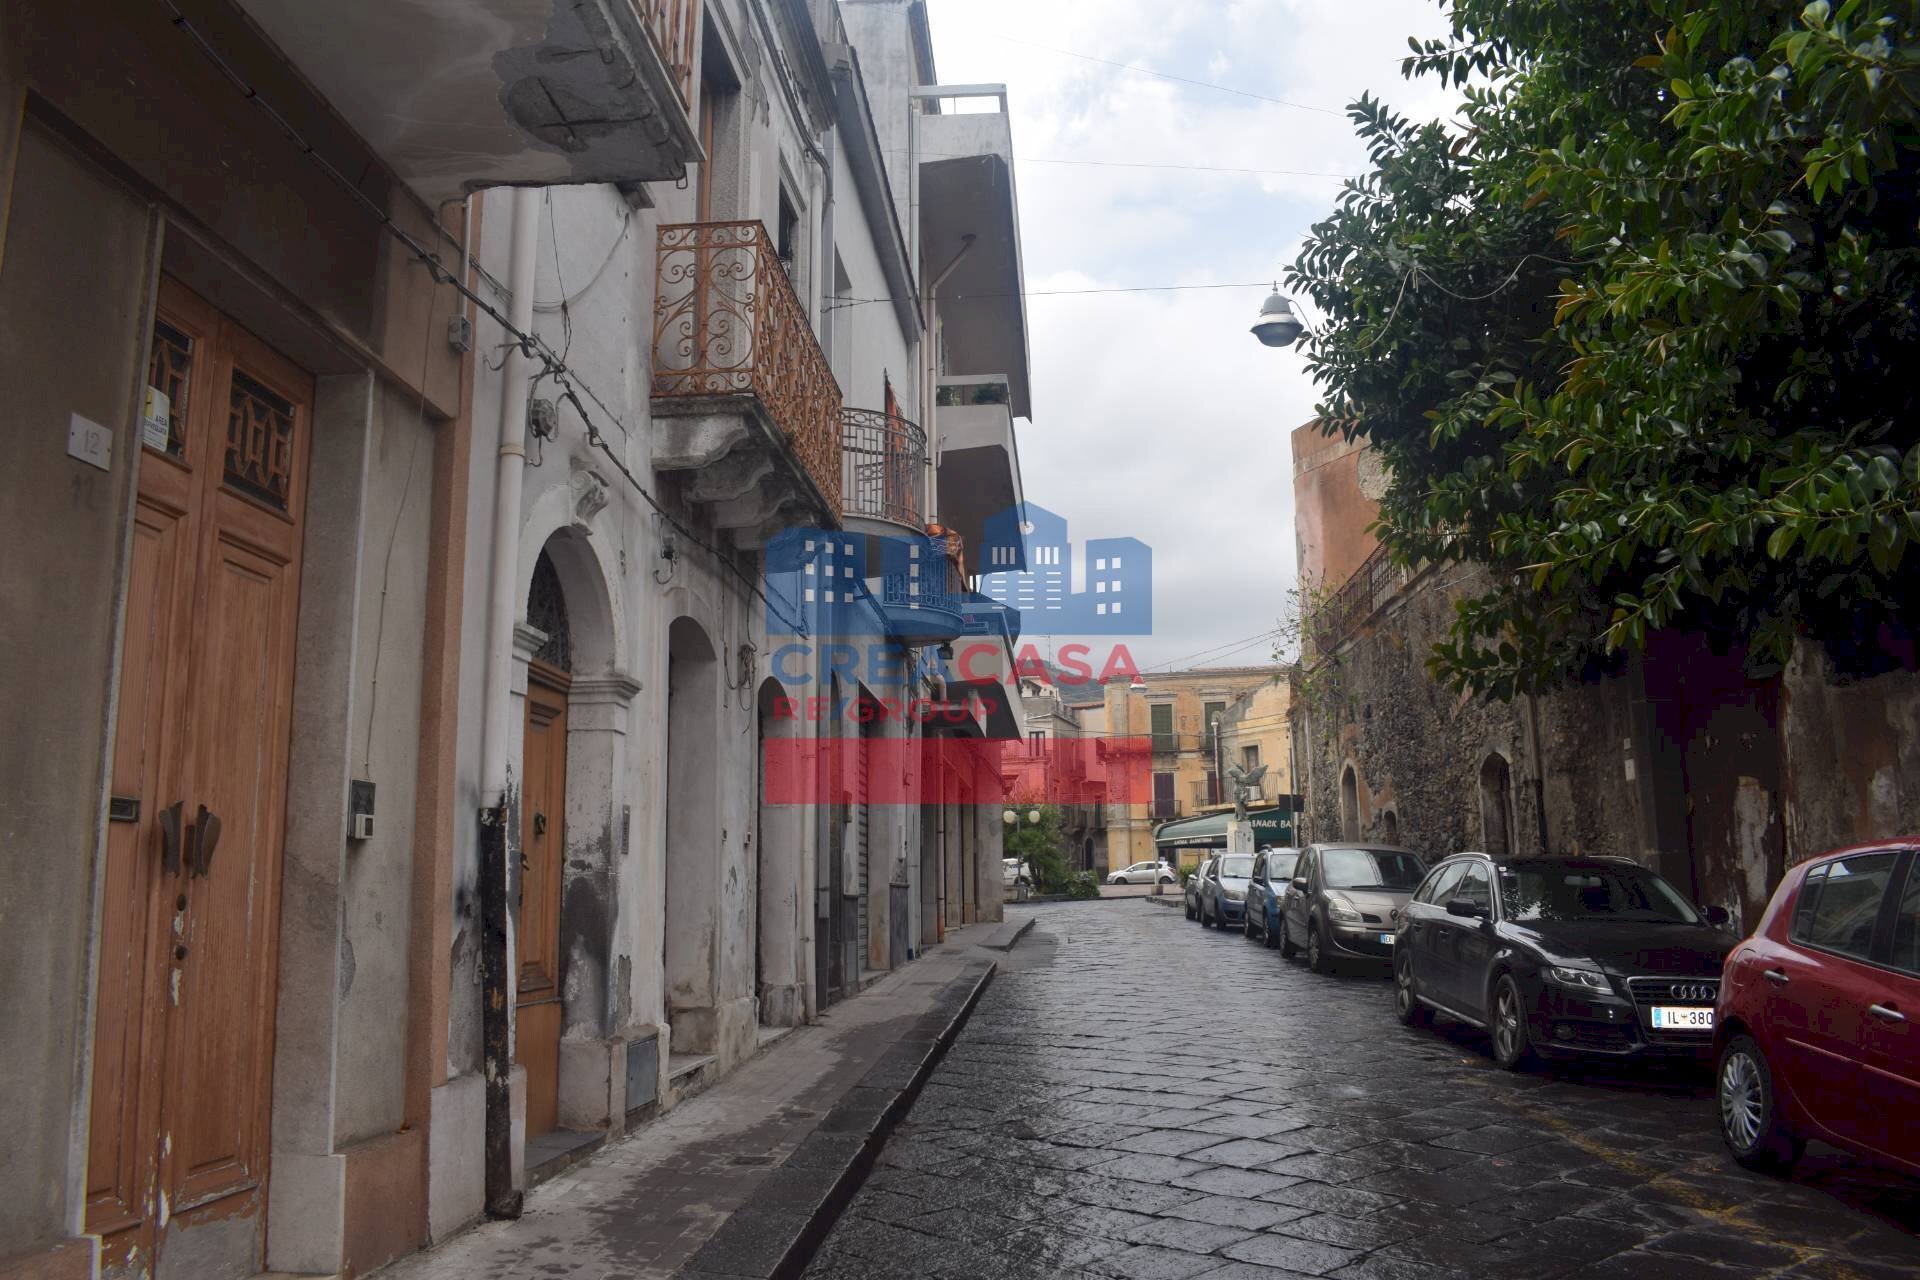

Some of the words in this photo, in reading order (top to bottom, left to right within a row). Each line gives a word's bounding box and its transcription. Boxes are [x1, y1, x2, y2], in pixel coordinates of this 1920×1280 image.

[84, 430, 100, 456] 12
[1251, 819, 1277, 828] SNACK
[1280, 820, 1292, 829] BA
[1668, 1011, 1679, 1024] IL
